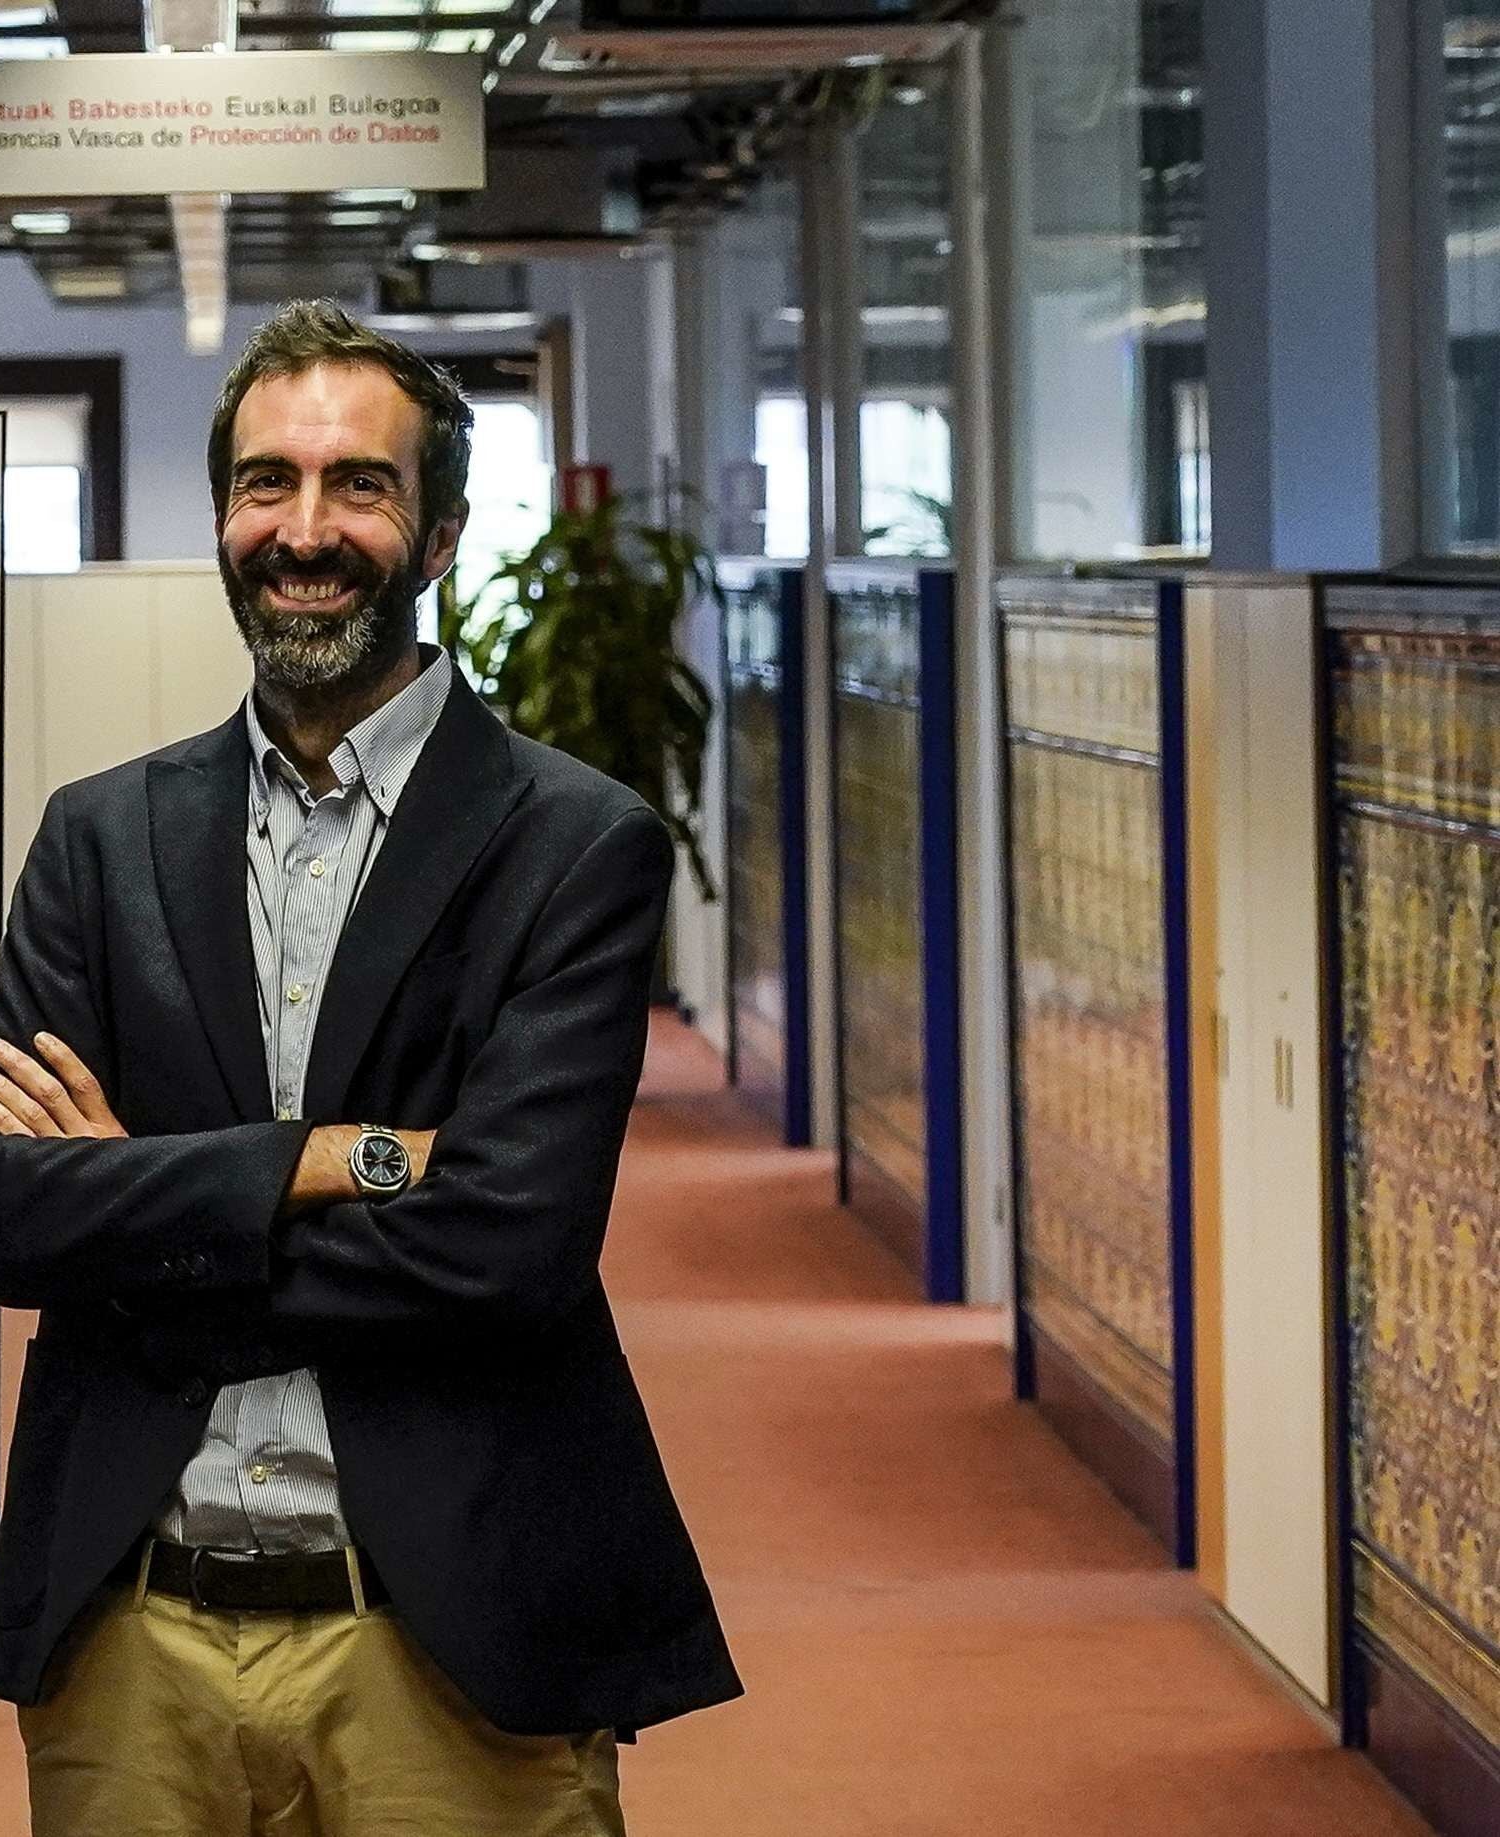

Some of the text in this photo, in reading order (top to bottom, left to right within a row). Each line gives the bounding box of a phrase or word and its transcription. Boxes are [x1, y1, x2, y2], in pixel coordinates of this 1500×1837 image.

[68, 99, 212, 121] Babesteko
[225, 95, 316, 117] Euskal
[328, 94, 440, 119] Bulegoa
[68, 127, 144, 148] Vasca
[151, 127, 183, 147] de
[328, 122, 360, 145] de
[367, 121, 440, 143] Datos
